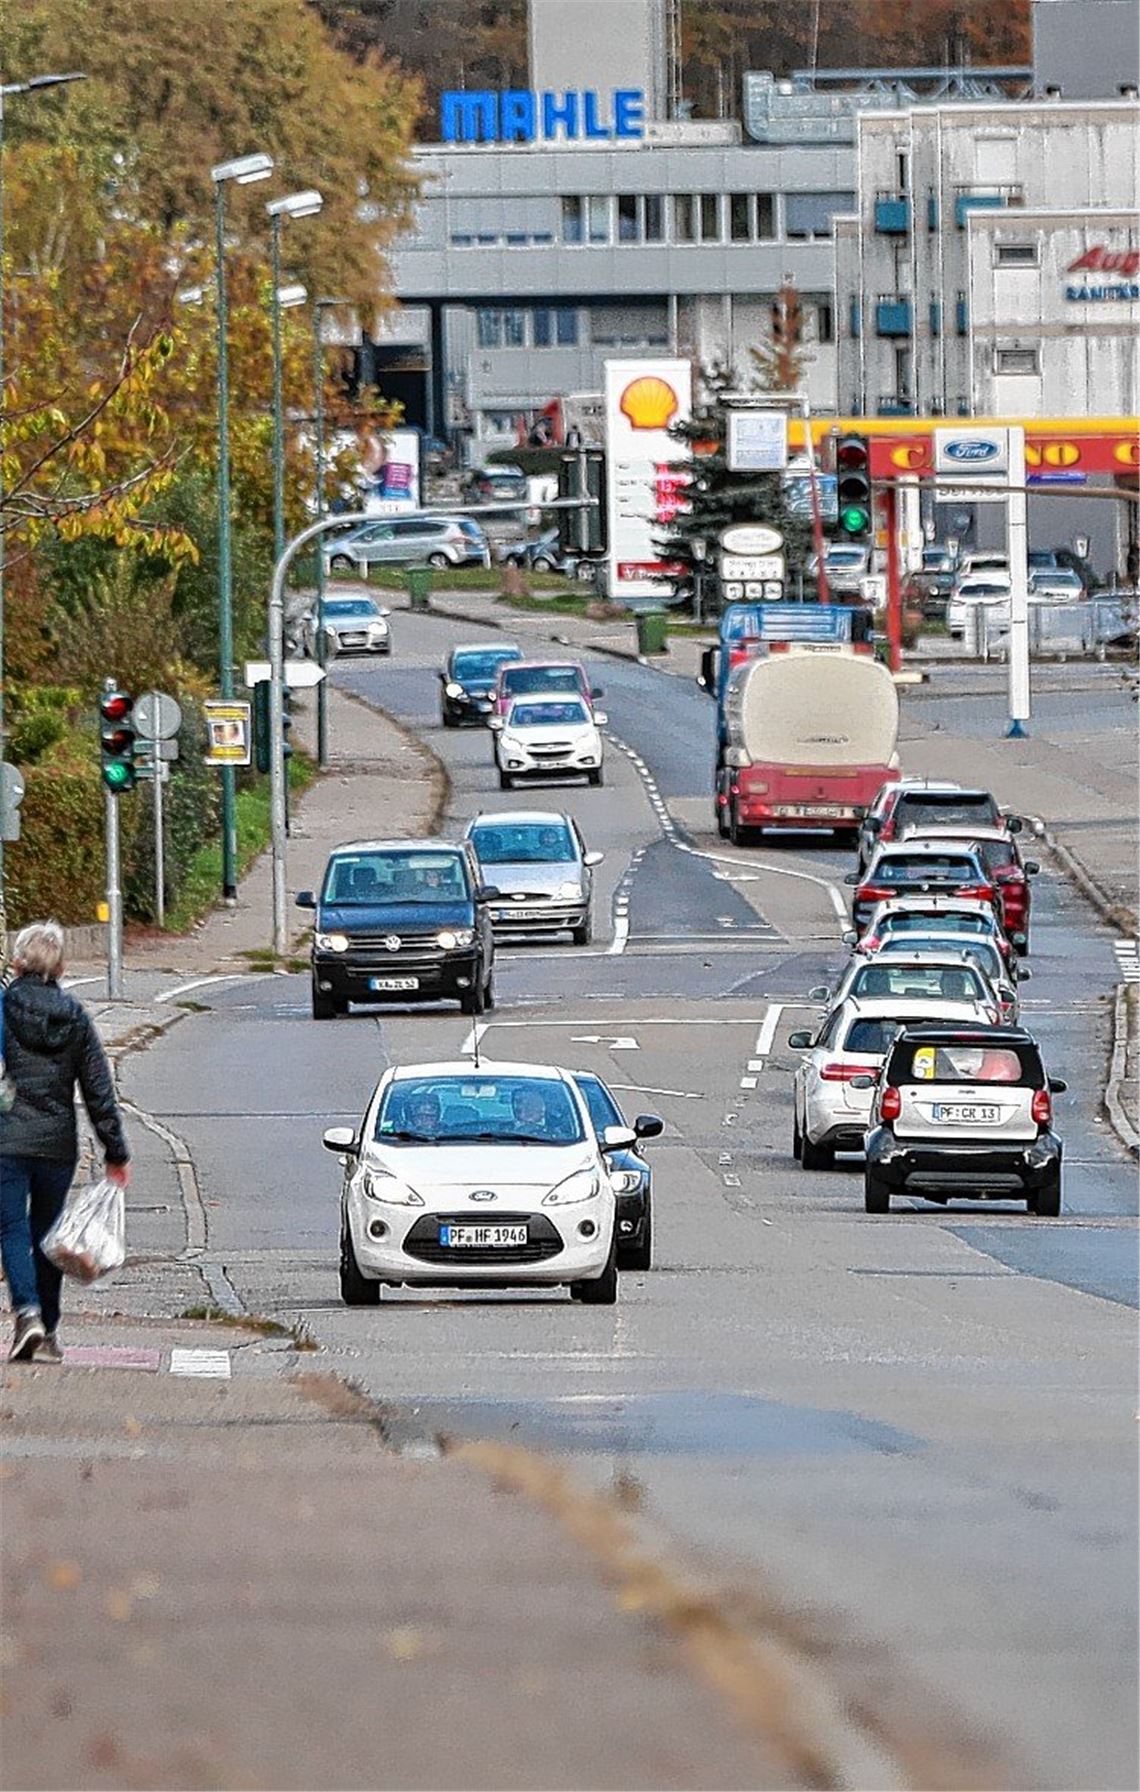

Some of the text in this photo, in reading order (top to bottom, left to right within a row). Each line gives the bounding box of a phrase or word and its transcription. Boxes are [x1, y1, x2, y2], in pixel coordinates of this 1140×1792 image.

[440, 91, 645, 142] MAHLE
[956, 443, 989, 458] Ford
[981, 1108, 995, 1119] 13
[450, 1228, 525, 1242] PF HF 1946
